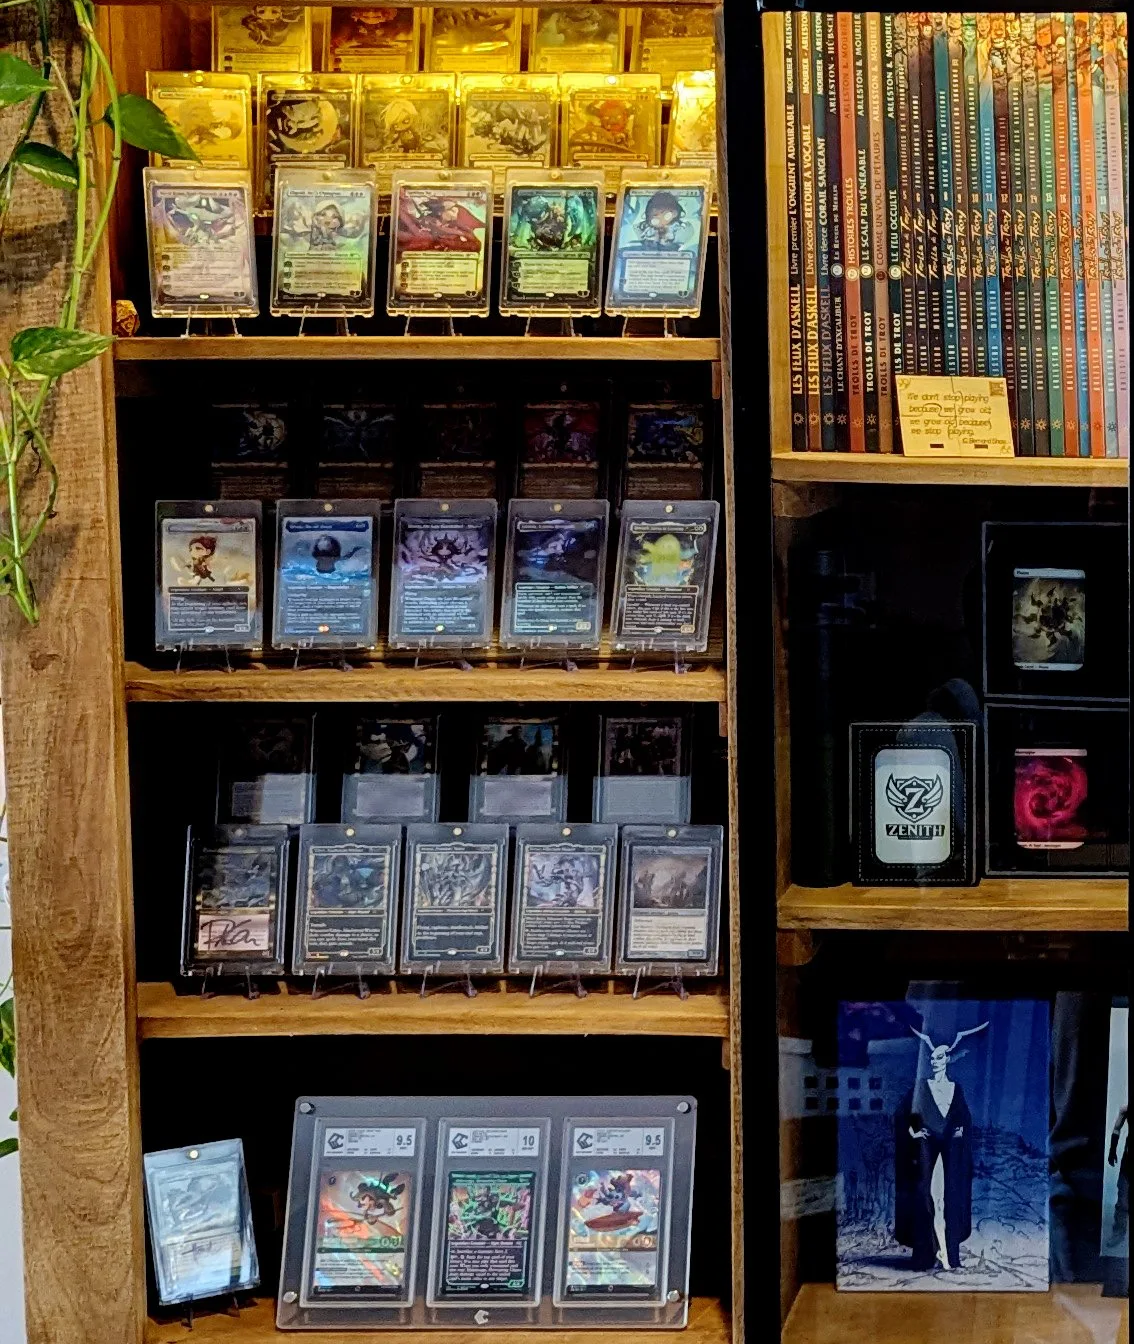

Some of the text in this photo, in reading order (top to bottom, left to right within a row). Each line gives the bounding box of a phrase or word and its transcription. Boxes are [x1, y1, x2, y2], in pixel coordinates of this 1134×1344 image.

[856, 69, 865, 116] ARLESTON
[871, 74, 880, 122] ARLESTON
[786, 104, 799, 274] Livre premier L'ONGUENT ADMIRABLE
[802, 124, 814, 275] Livre second RETOUR VOCABLE
[817, 137, 829, 276] Livre CORAIL SANGLANT
[874, 193, 883, 211] VOL
[860, 219, 870, 260] LE SCALP
[891, 252, 899, 262] LE
[790, 284, 802, 394] LES FEUX D'ASKELL
[806, 285, 819, 394] LES FEUX D'ASKELL
[820, 285, 833, 395] LES D'ASKELL
[864, 311, 873, 353] DE TROY
[893, 313, 901, 338] TROY
[965, 395, 989, 403] playing
[885, 823, 946, 837] ZENITH
[396, 1134, 413, 1146] 9.5
[522, 1135, 535, 1147] 10
[645, 1134, 662, 1146] 9.5
